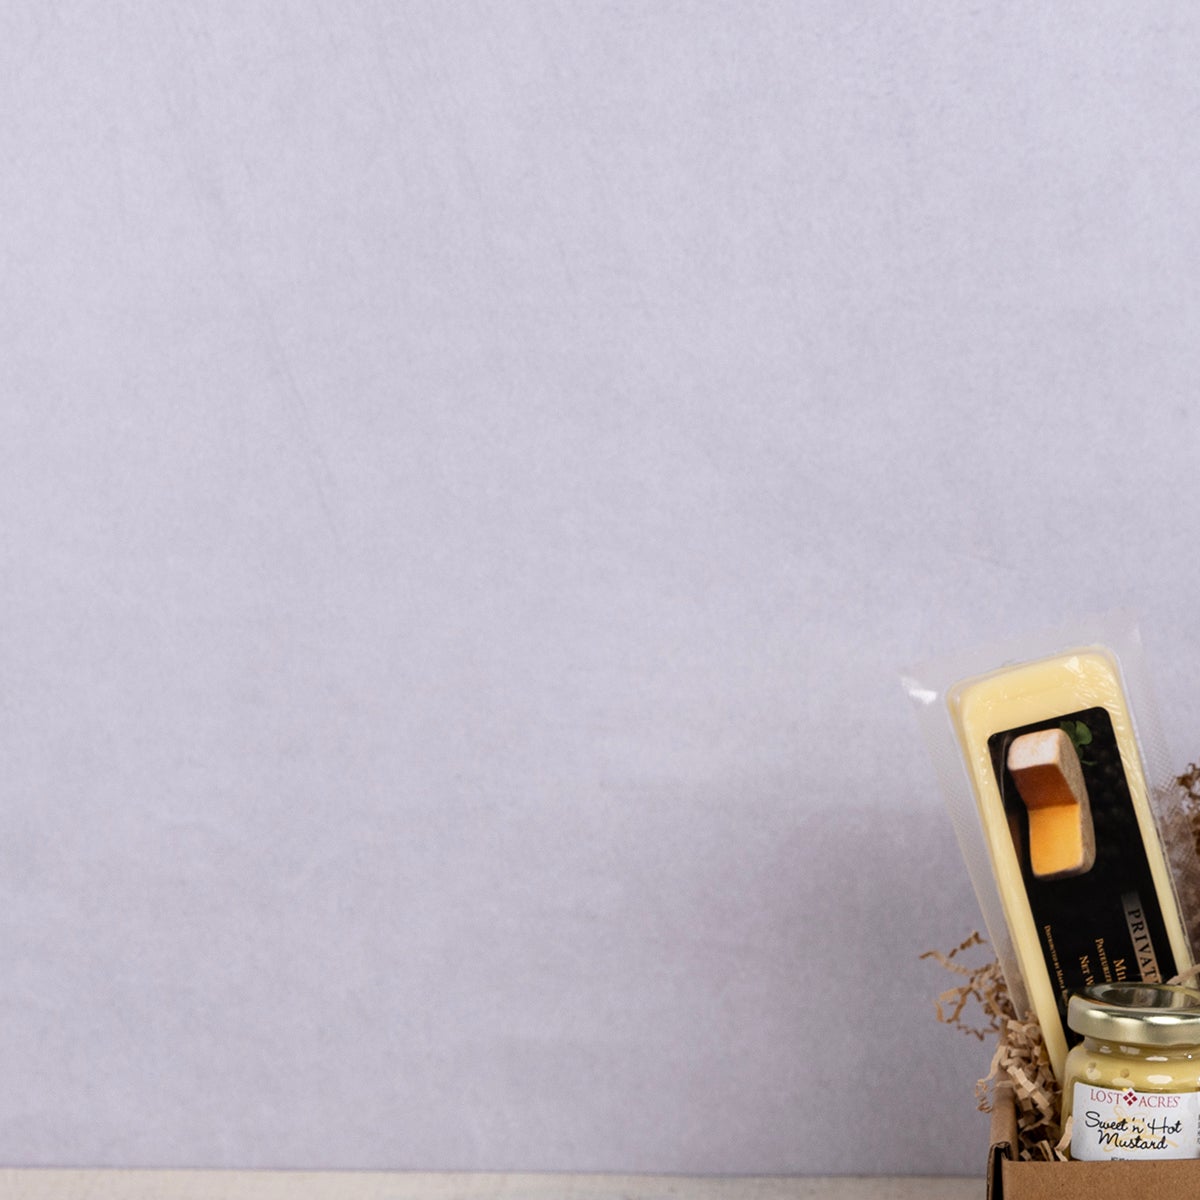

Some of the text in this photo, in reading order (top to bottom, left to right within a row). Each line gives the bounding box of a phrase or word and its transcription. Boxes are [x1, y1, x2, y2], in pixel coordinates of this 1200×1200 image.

[1128, 908, 1162, 984] PRIVAT
[1090, 1089, 1180, 1108] LOST ACRES
[1085, 1110, 1128, 1132] Sweet
[1147, 1117, 1182, 1135] Hot
[1098, 1129, 1168, 1150] Mustard
